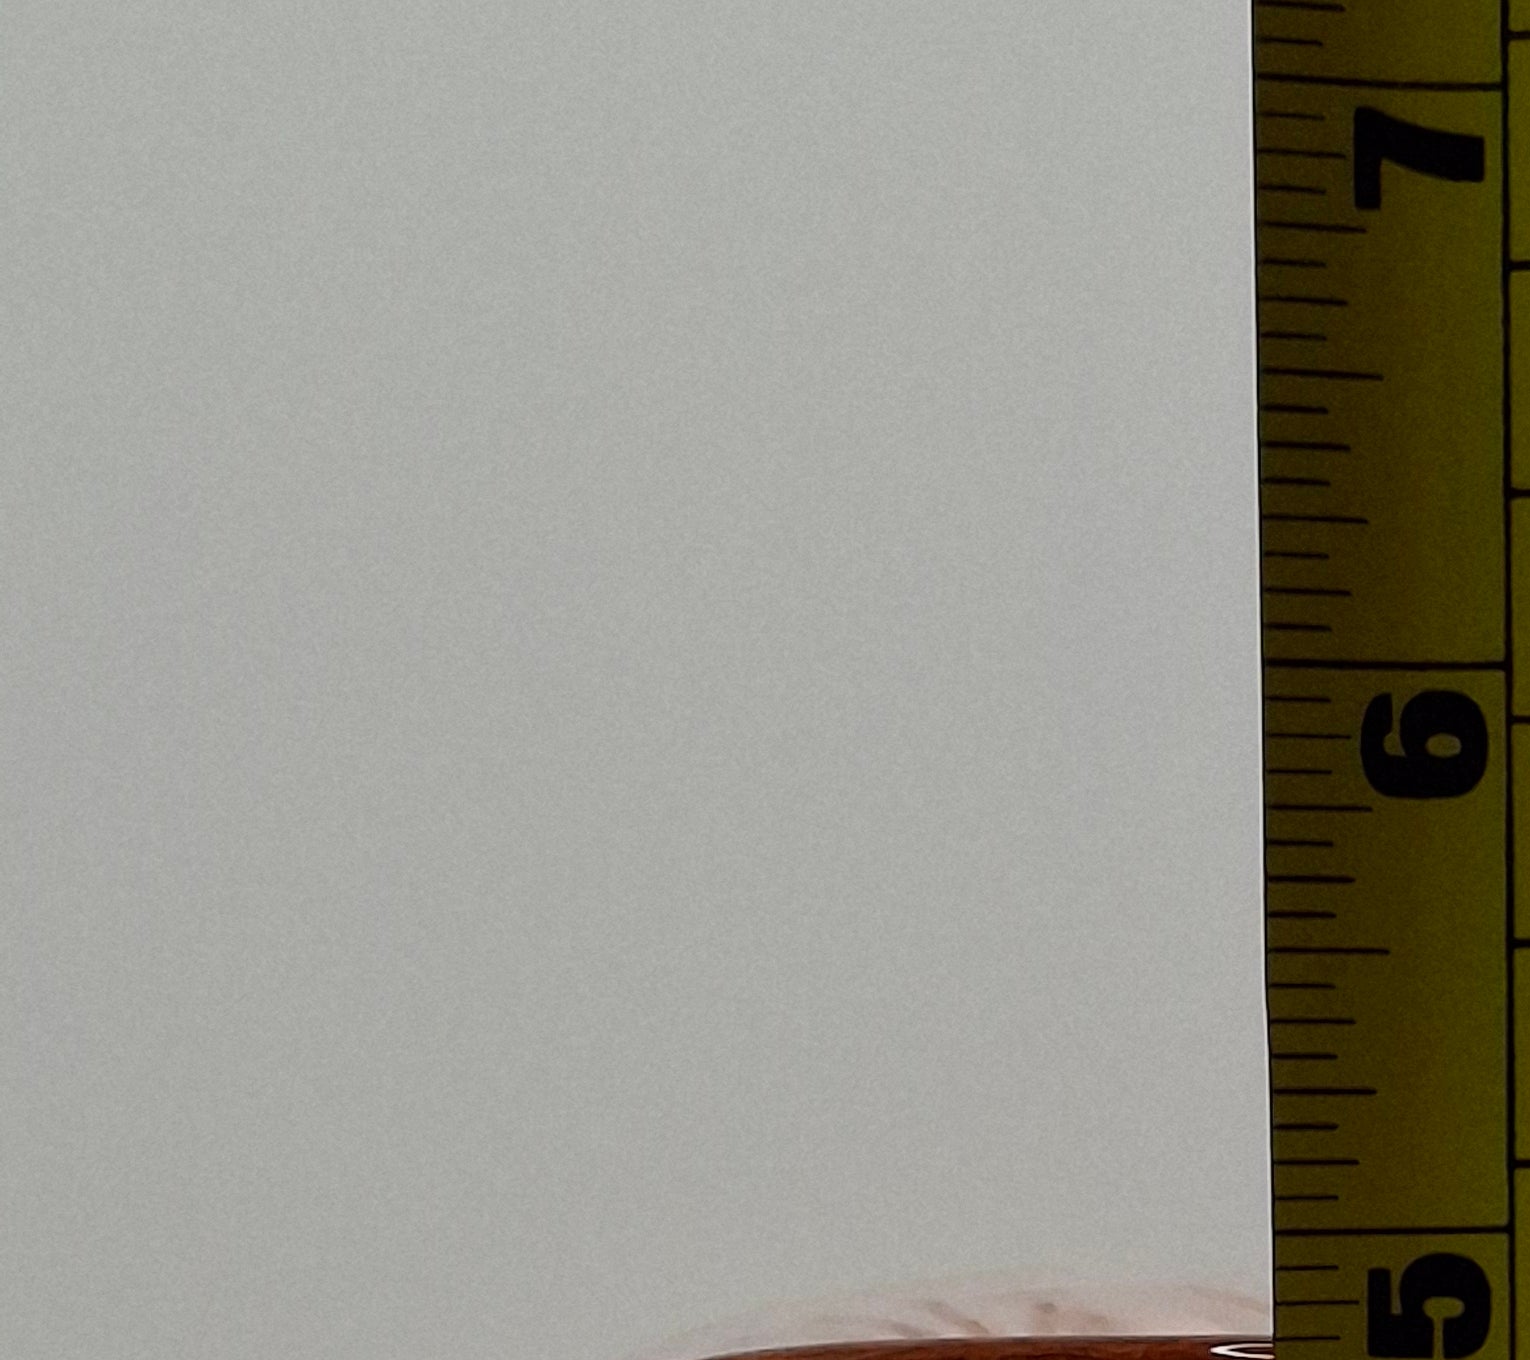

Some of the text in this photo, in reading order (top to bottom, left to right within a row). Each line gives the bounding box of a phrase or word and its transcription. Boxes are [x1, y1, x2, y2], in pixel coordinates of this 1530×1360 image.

[1353, 106, 1486, 211] 7
[1360, 688, 1489, 801] 6
[1366, 1252, 1492, 1360] 5
